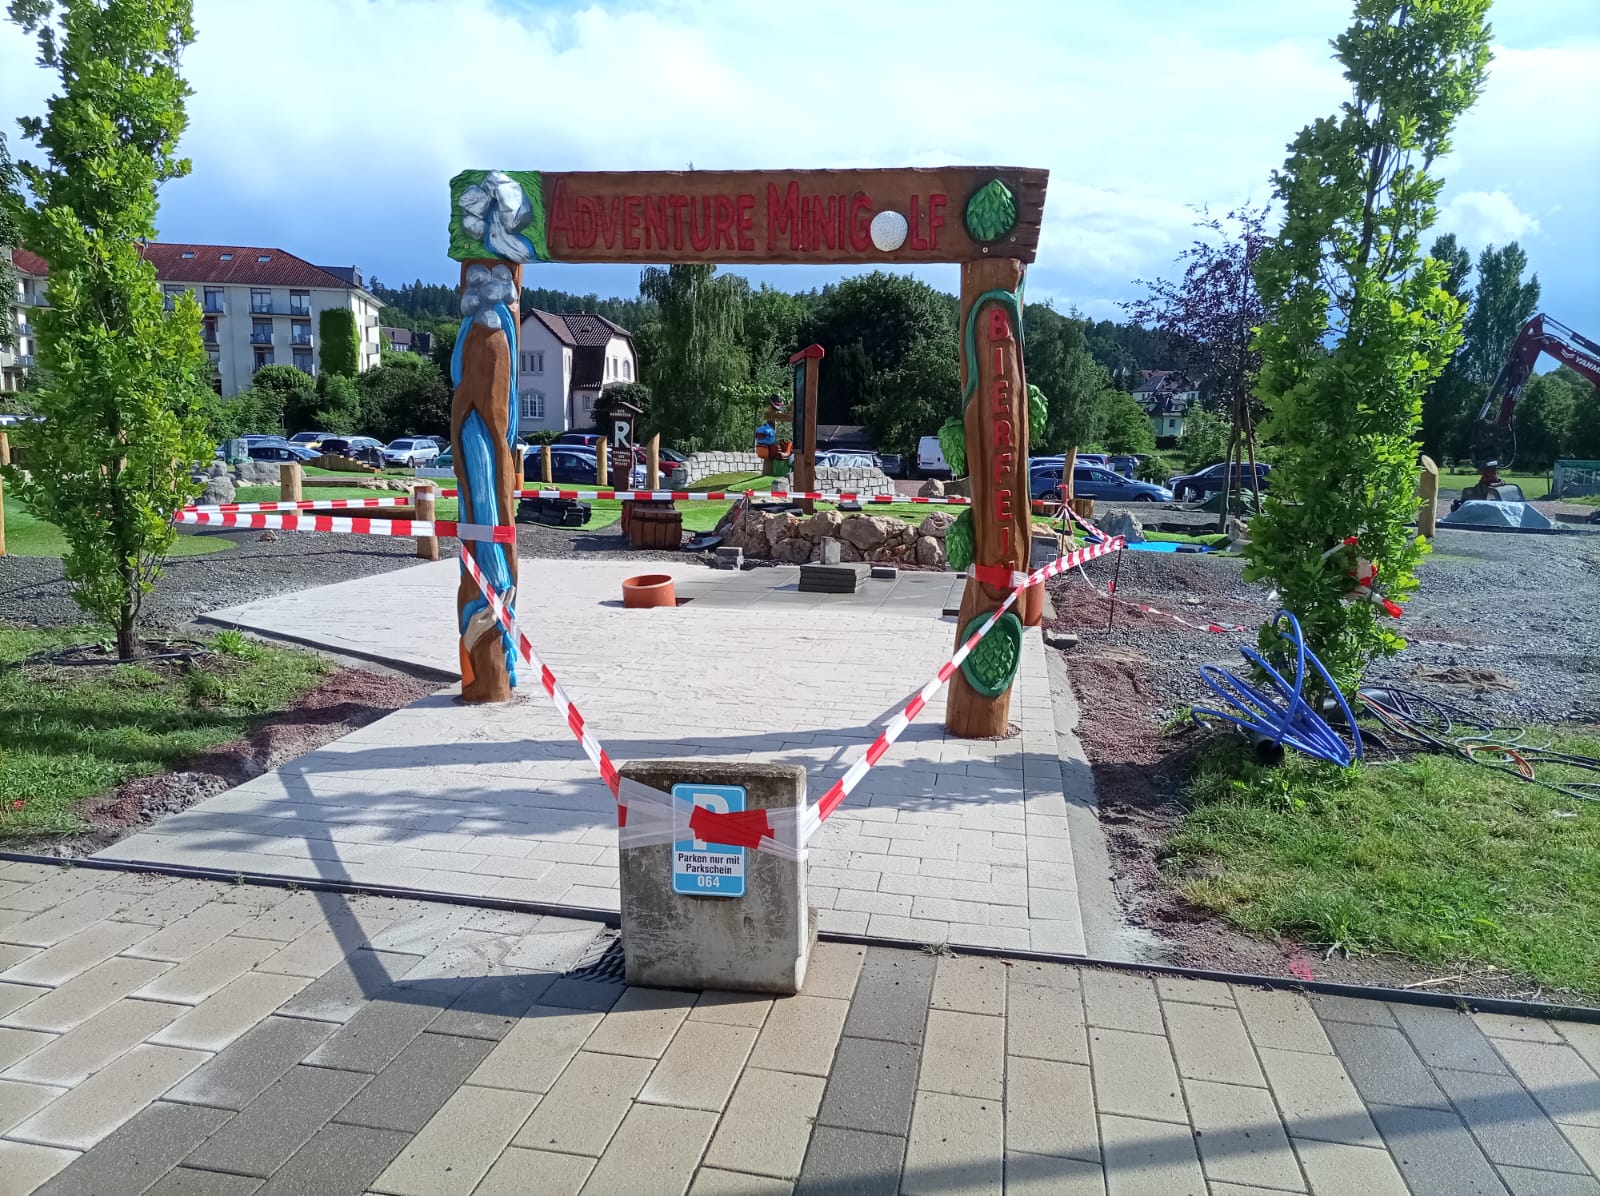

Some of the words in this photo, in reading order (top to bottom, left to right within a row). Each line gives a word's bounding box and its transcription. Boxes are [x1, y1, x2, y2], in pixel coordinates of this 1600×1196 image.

[546, 176, 756, 251] ADVENTURE
[614, 421, 631, 448] R
[678, 853, 707, 864] Parken
[709, 855, 724, 865] nur
[726, 856, 740, 865] mit
[685, 863, 732, 875] Parkschein
[697, 875, 720, 888] 064
